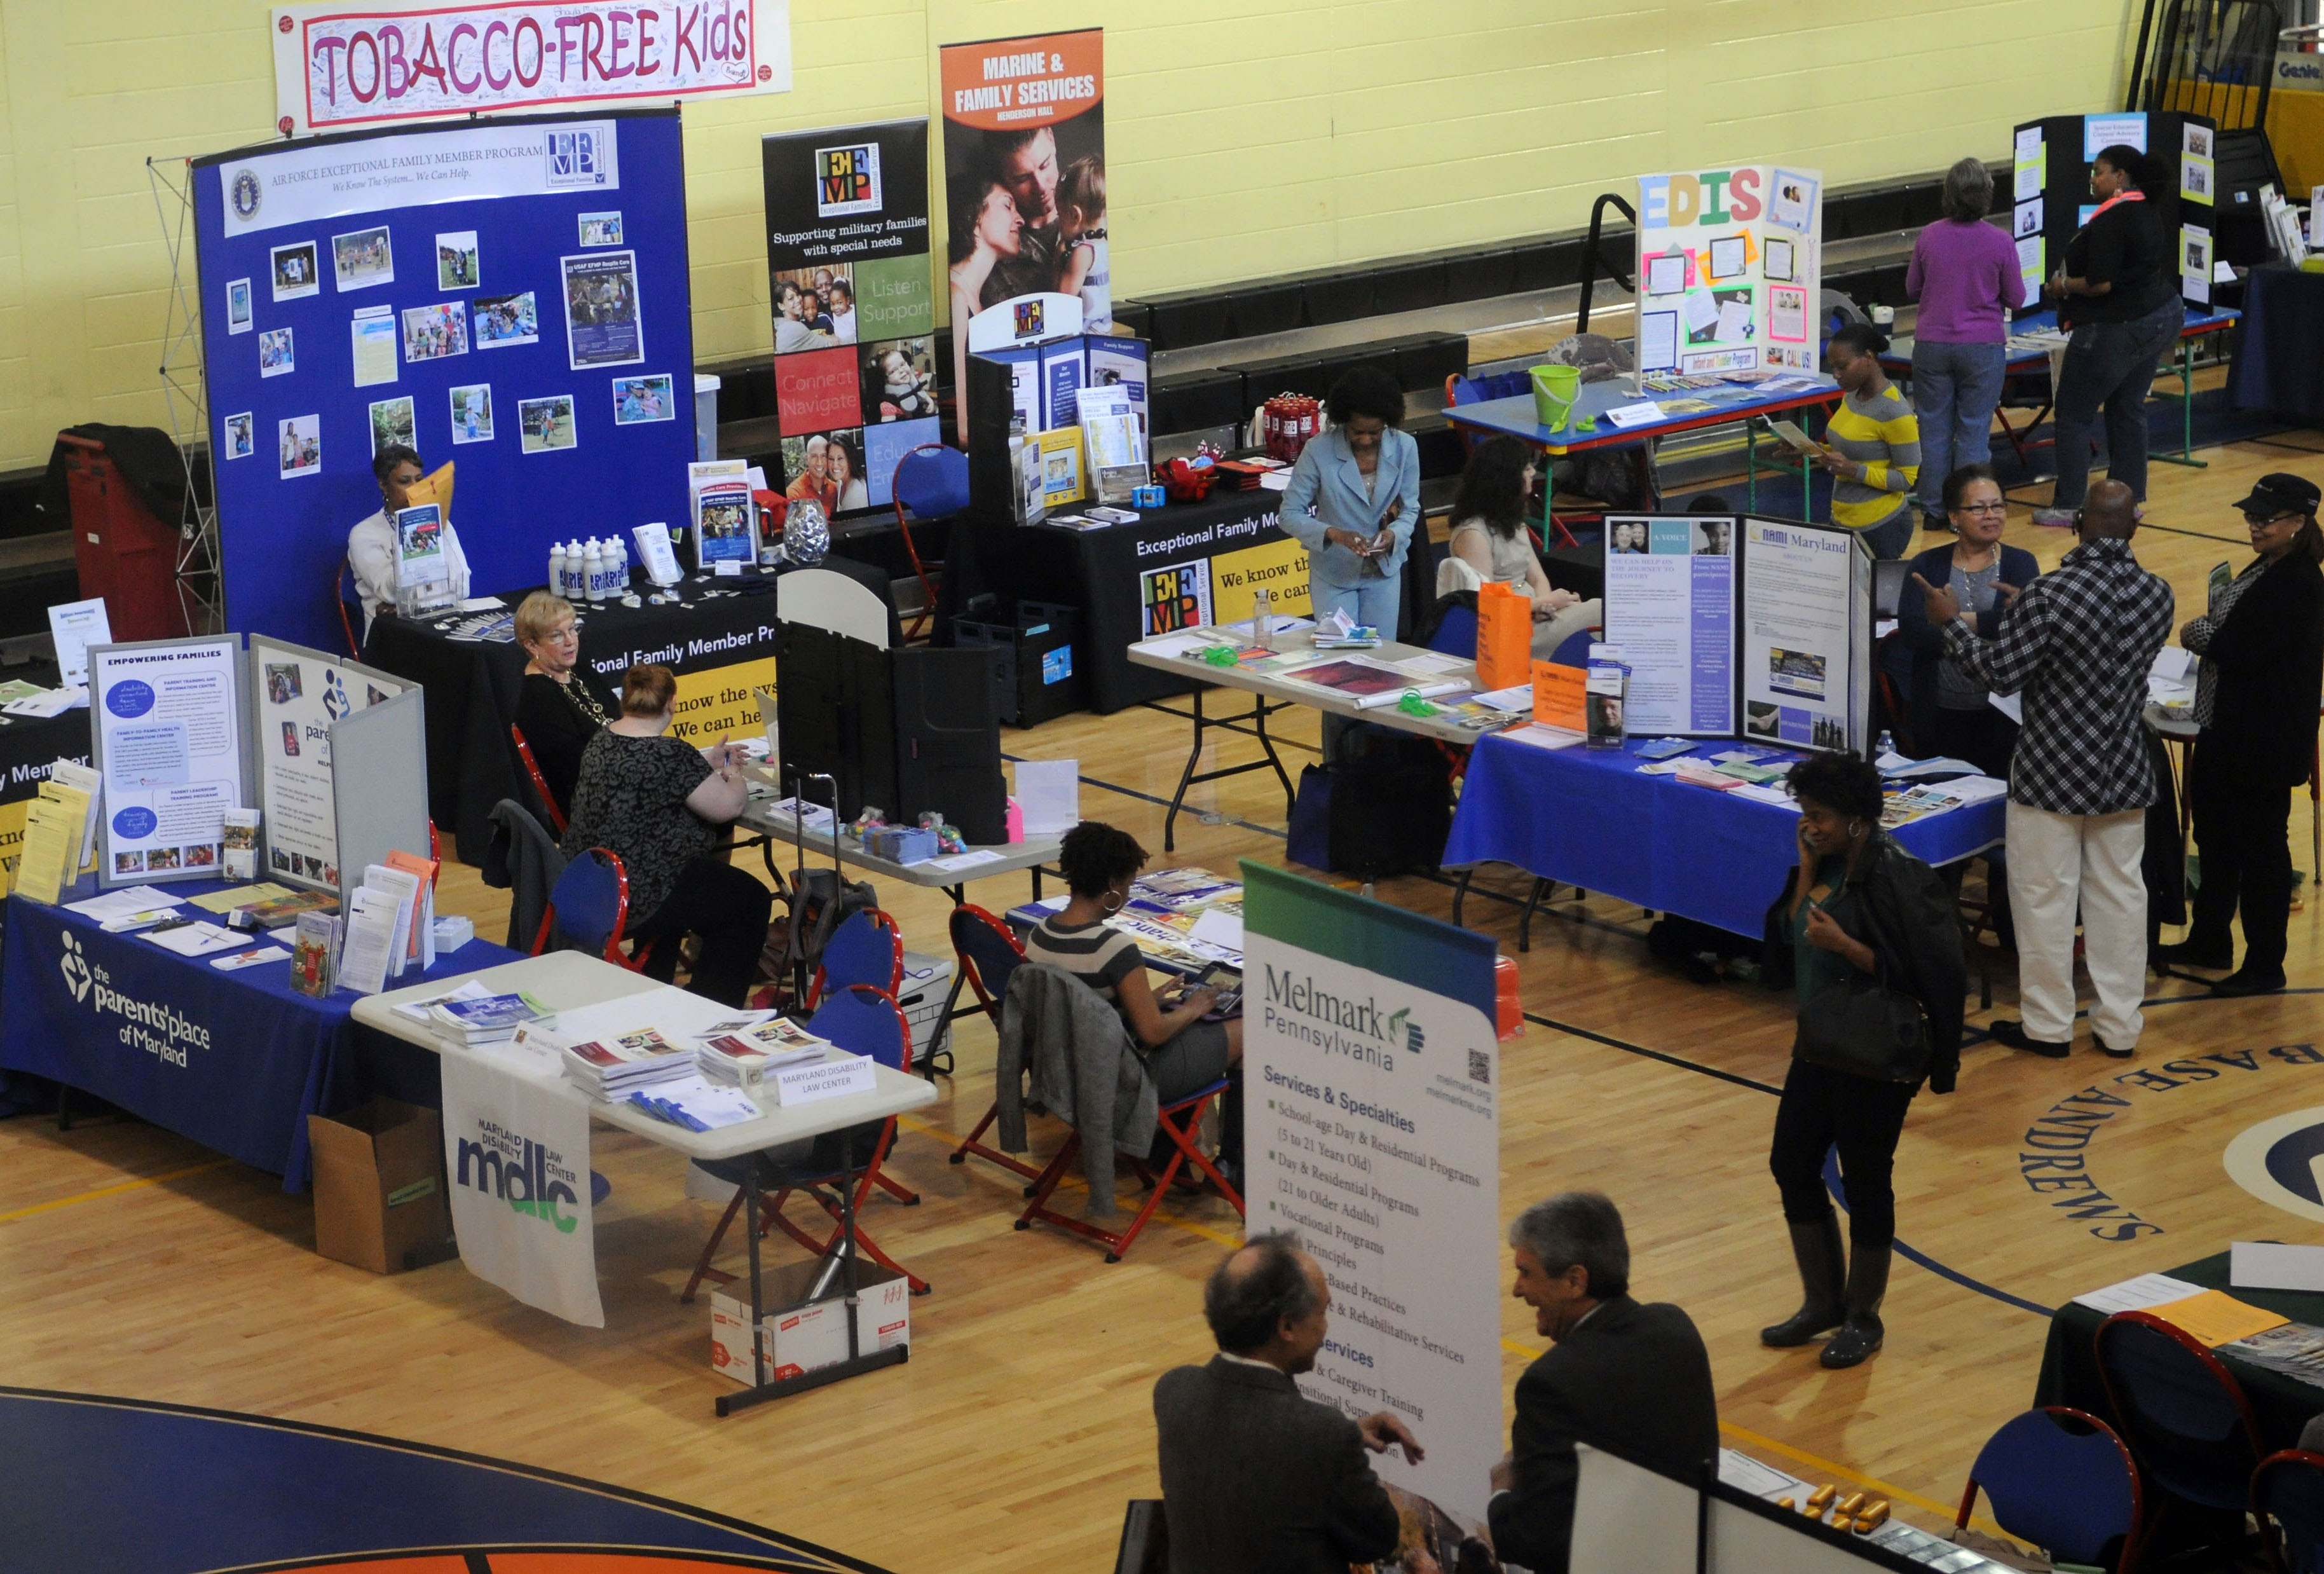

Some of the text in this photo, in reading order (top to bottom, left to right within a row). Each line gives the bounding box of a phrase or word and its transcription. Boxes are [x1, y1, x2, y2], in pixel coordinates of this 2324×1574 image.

[313, 0, 746, 107] TOBACCO-FREE Kids
[983, 51, 1064, 80] MARINE &
[2278, 61, 2320, 78] Genie
[955, 74, 1095, 113] FAMILY SERVICES
[997, 106, 1054, 121] HENDERSON HALL
[271, 146, 543, 187] AIR FORCE EXCEPTIONAL FAMILY MEMBER PROGRAM
[332, 182, 345, 192] We
[346, 180, 367, 190] Know
[367, 177, 384, 187] The
[416, 171, 430, 181] We
[431, 170, 449, 180] Can
[450, 168, 471, 181] Help.
[820, 201, 872, 215] Exceptional Families
[1639, 168, 1762, 229] EDIS
[774, 217, 927, 245] Supporting military families
[803, 236, 903, 257] with special needs
[872, 280, 921, 298] Listen
[863, 300, 931, 324] Support
[1733, 352, 1751, 368] Program
[1787, 350, 1801, 368] CALL
[783, 369, 854, 392] Connect
[782, 395, 857, 417] Navigate
[1137, 517, 1259, 556] Exceptional Family
[1791, 533, 1847, 554] Maryland
[1220, 564, 1289, 589] We know
[108, 650, 222, 666] EMPOWERING FAMILIES
[633, 643, 684, 666] Family
[689, 632, 754, 657] Member
[720, 688, 748, 704] the
[673, 716, 735, 739] We can
[321, 744, 329, 755] of
[94, 964, 109, 985] the
[1264, 962, 1386, 1042] Melmark
[120, 1024, 188, 1068] of Maryland
[1265, 1006, 1393, 1072] Pennsylvania
[783, 1061, 867, 1084] MARYLAND DISABILITY
[803, 1077, 851, 1093] LAW CENTER
[1264, 1065, 1416, 1134] Services & Specialties
[1436, 1074, 1492, 1103] melmark.org
[478, 1118, 522, 1146] MARYLAND
[1278, 1101, 1480, 1187] School-age Day & Residential Programs
[2019, 1043, 2324, 1242] BASE ANDREWS
[481, 1133, 522, 1160] DISABILITY
[545, 1148, 563, 1164] LAW
[1277, 1126, 1372, 1175] (5 to 21 Years Old)
[456, 1137, 578, 1234] mdlc
[545, 1162, 577, 1184] CENTER
[1278, 1153, 1419, 1217] Day & Residential Programs
[1278, 1177, 1379, 1228] (21 to Older Adults)
[1280, 1203, 1384, 1255] Vocational Programs
[1306, 1238, 1357, 1270] Principles
[1361, 1285, 1407, 1316] Practices
[1337, 1305, 1347, 1317] &
[1350, 1306, 1425, 1347] Rehabilitative
[1421, 1336, 1465, 1365] Services
[1320, 1338, 1374, 1368] ervices
[1316, 1363, 1425, 1422] & Caregiver Training
